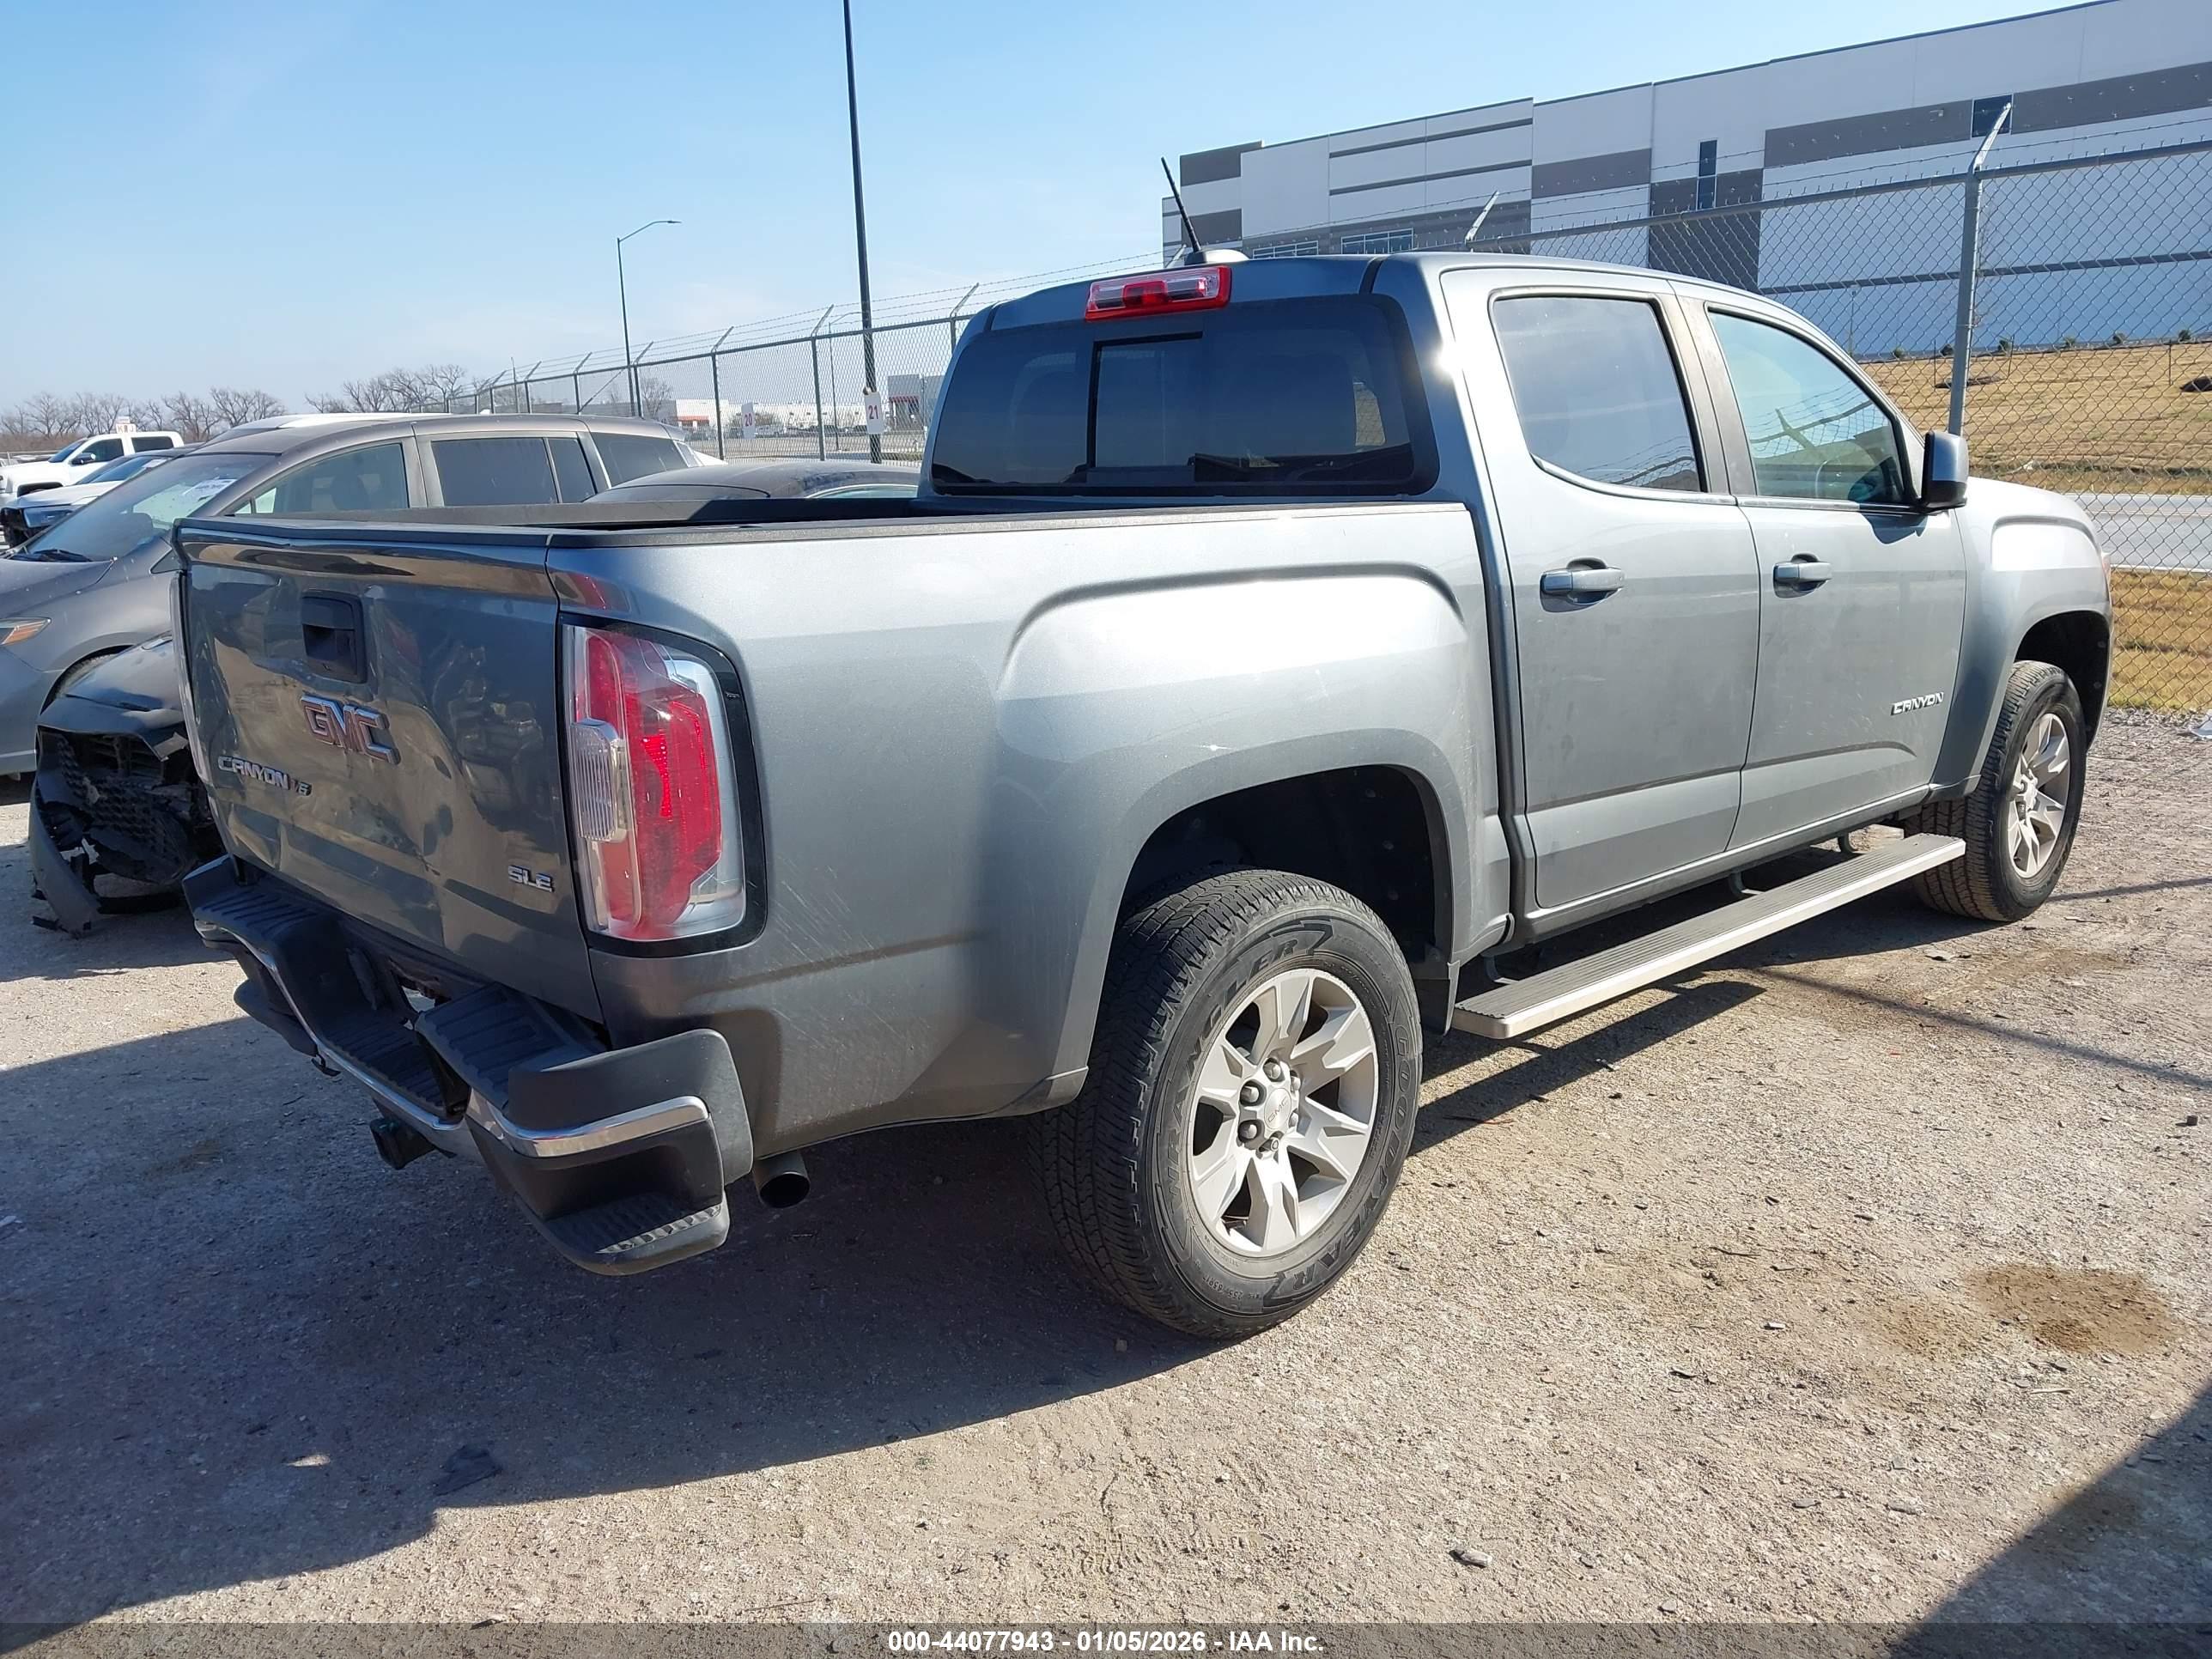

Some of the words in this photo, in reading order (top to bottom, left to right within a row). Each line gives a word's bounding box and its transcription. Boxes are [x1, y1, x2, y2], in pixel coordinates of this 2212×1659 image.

[744, 412, 753, 427] 20
[868, 404, 879, 420] 21
[1891, 692, 1944, 715] CANYON
[301, 695, 401, 765] GMC
[217, 756, 289, 790] CANYON
[508, 865, 555, 893] SLE
[1267, 1097, 1288, 1123] GMC
[1290, 1023, 1417, 1293] GOODYEAR
